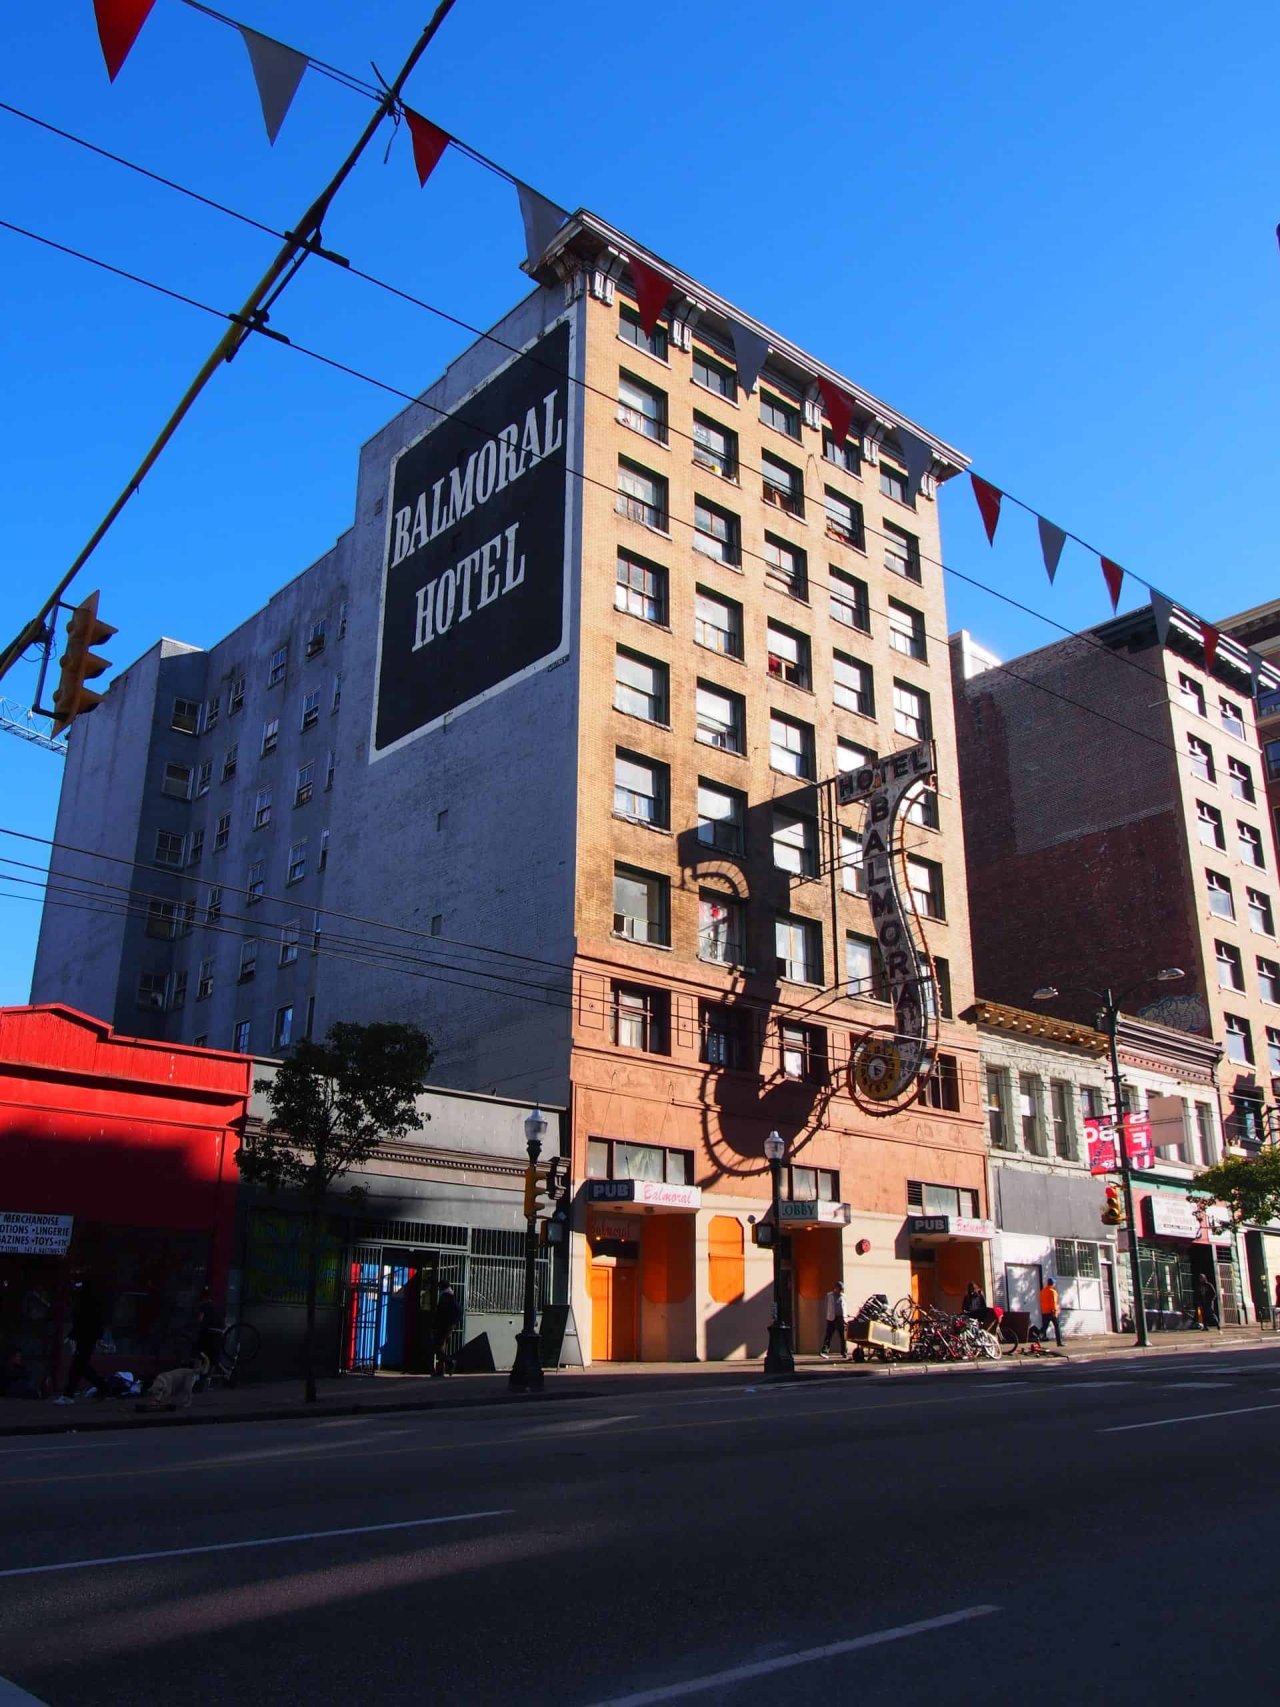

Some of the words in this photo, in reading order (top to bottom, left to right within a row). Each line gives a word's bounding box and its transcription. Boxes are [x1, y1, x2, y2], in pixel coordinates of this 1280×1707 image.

[391, 389, 562, 569] BALMORAL
[412, 522, 525, 652] HOTEL
[839, 748, 928, 798] HOTEL
[863, 795, 919, 1043] BALMORAL
[593, 1184, 629, 1197] PUB
[644, 1183, 691, 1204] Balmoral
[4, 1214, 59, 1225] MERCHANDISE
[914, 1220, 945, 1230] PUB
[35, 1226, 70, 1237] LINGERIE
[35, 1236, 54, 1246] TOYS
